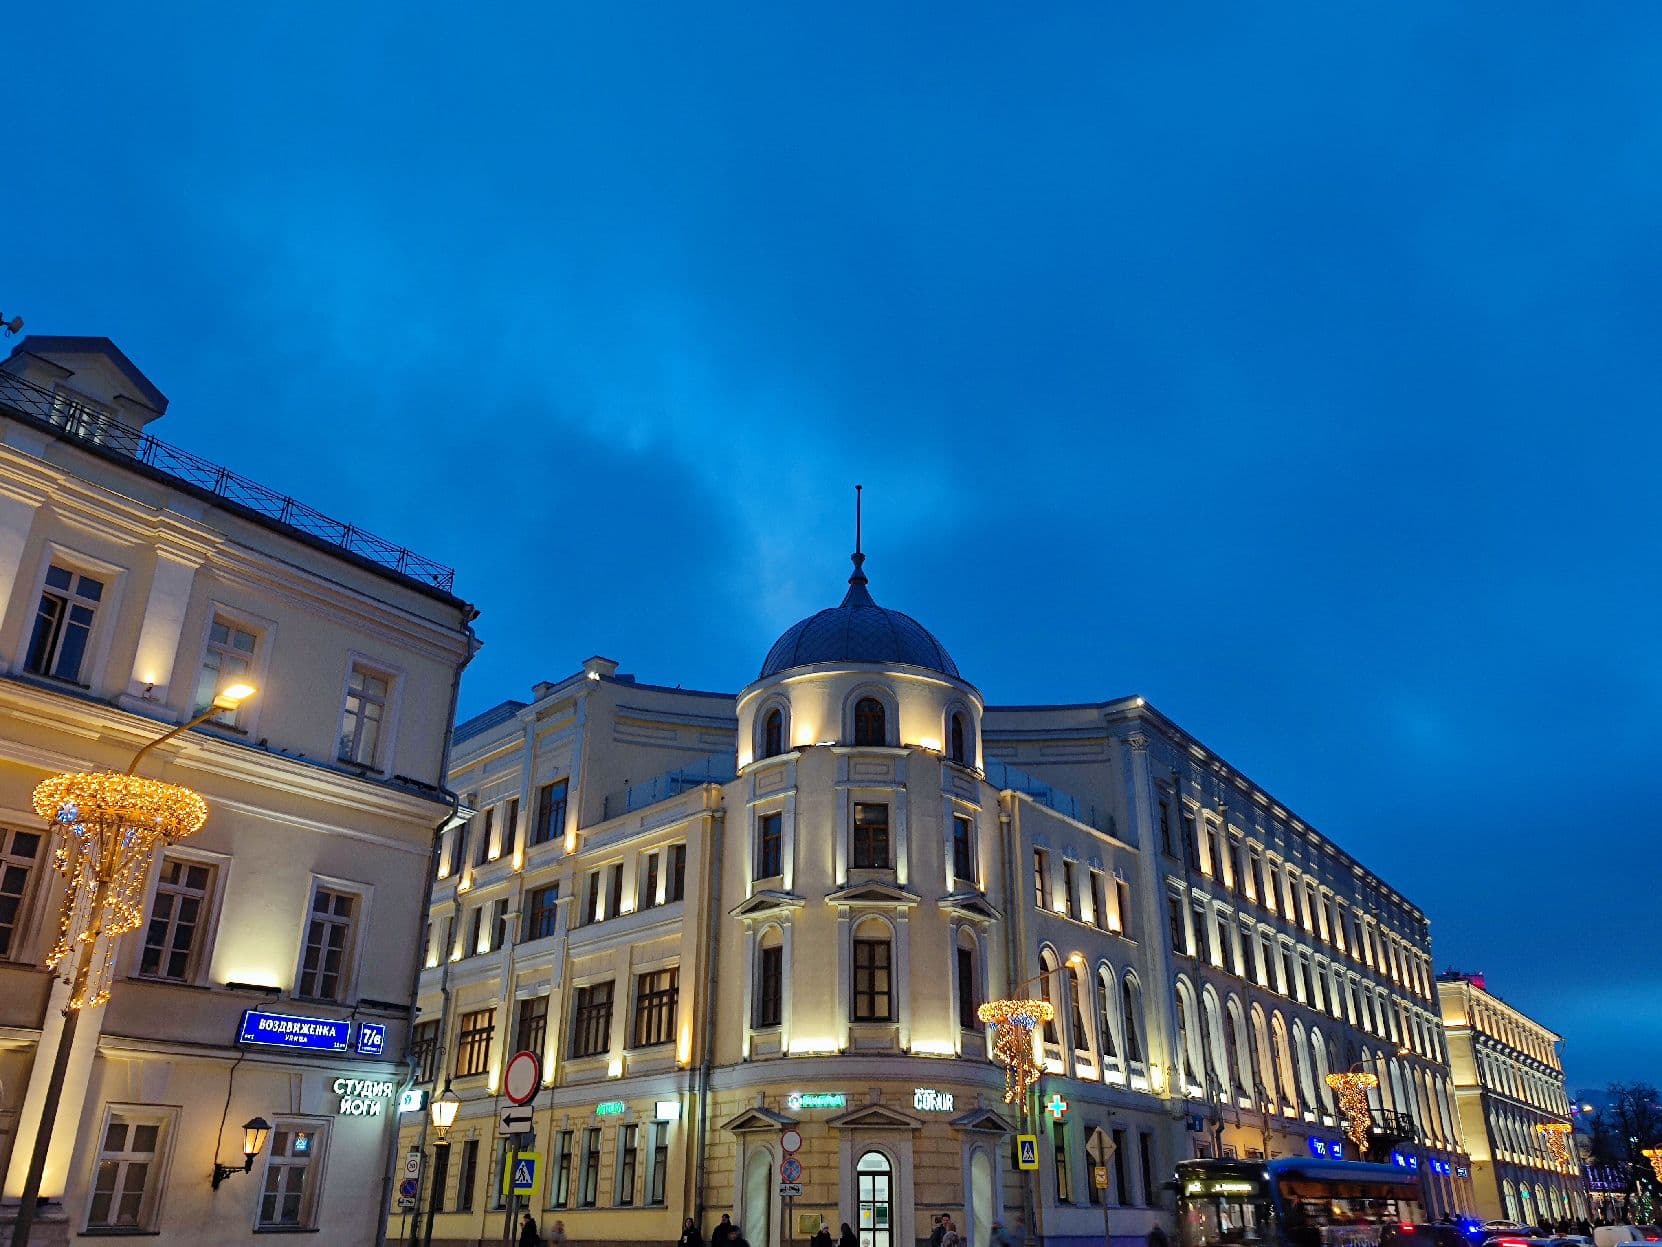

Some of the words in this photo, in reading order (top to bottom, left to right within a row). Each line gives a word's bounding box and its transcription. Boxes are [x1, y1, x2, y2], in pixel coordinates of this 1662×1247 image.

[258, 1018, 336, 1037] ВОЗДВИЖЕНКА
[333, 1078, 393, 1098] СТУДИЯ
[340, 1095, 380, 1116] ЙОГИ
